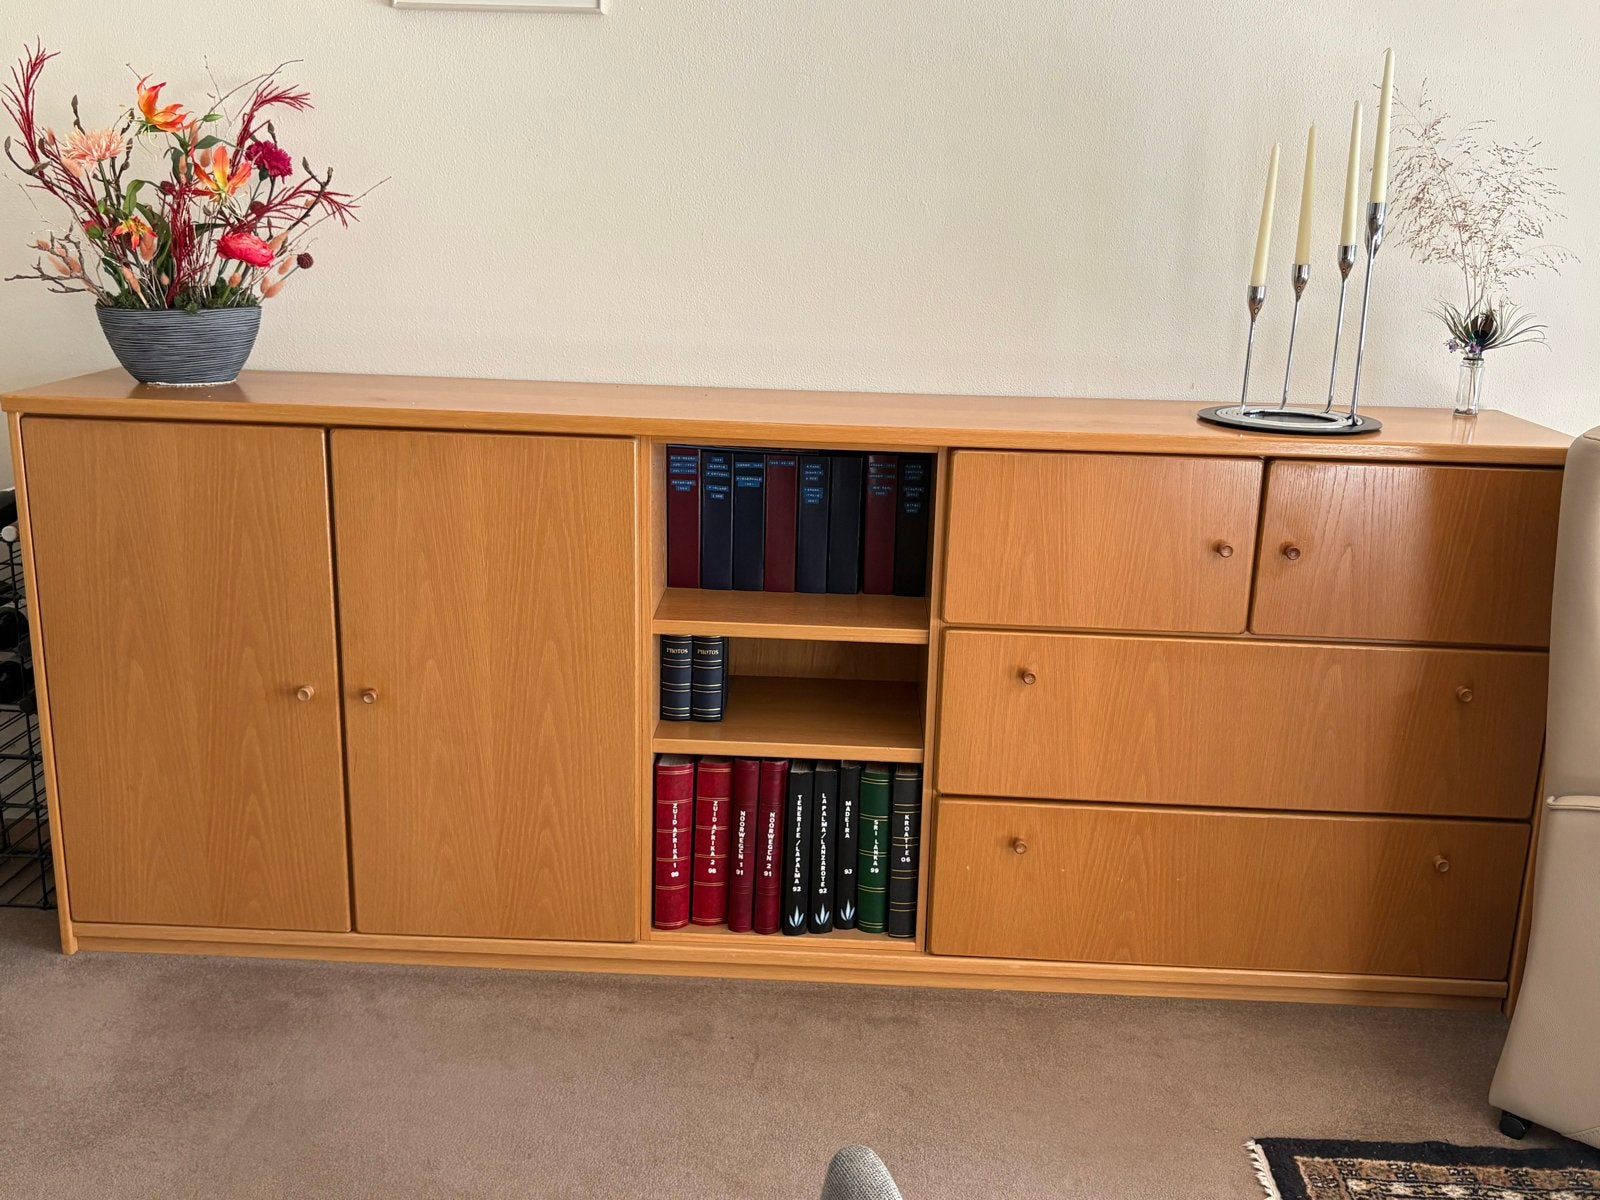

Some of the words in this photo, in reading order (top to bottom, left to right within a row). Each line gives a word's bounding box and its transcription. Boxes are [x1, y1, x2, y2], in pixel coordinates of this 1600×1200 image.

[710, 824, 718, 857] AFRIKA
[738, 811, 746, 859] NOORWEGEN
[766, 812, 775, 861] NOORWEGEN
[844, 800, 852, 839] MADEIRA
[903, 814, 911, 856] KROATIE
